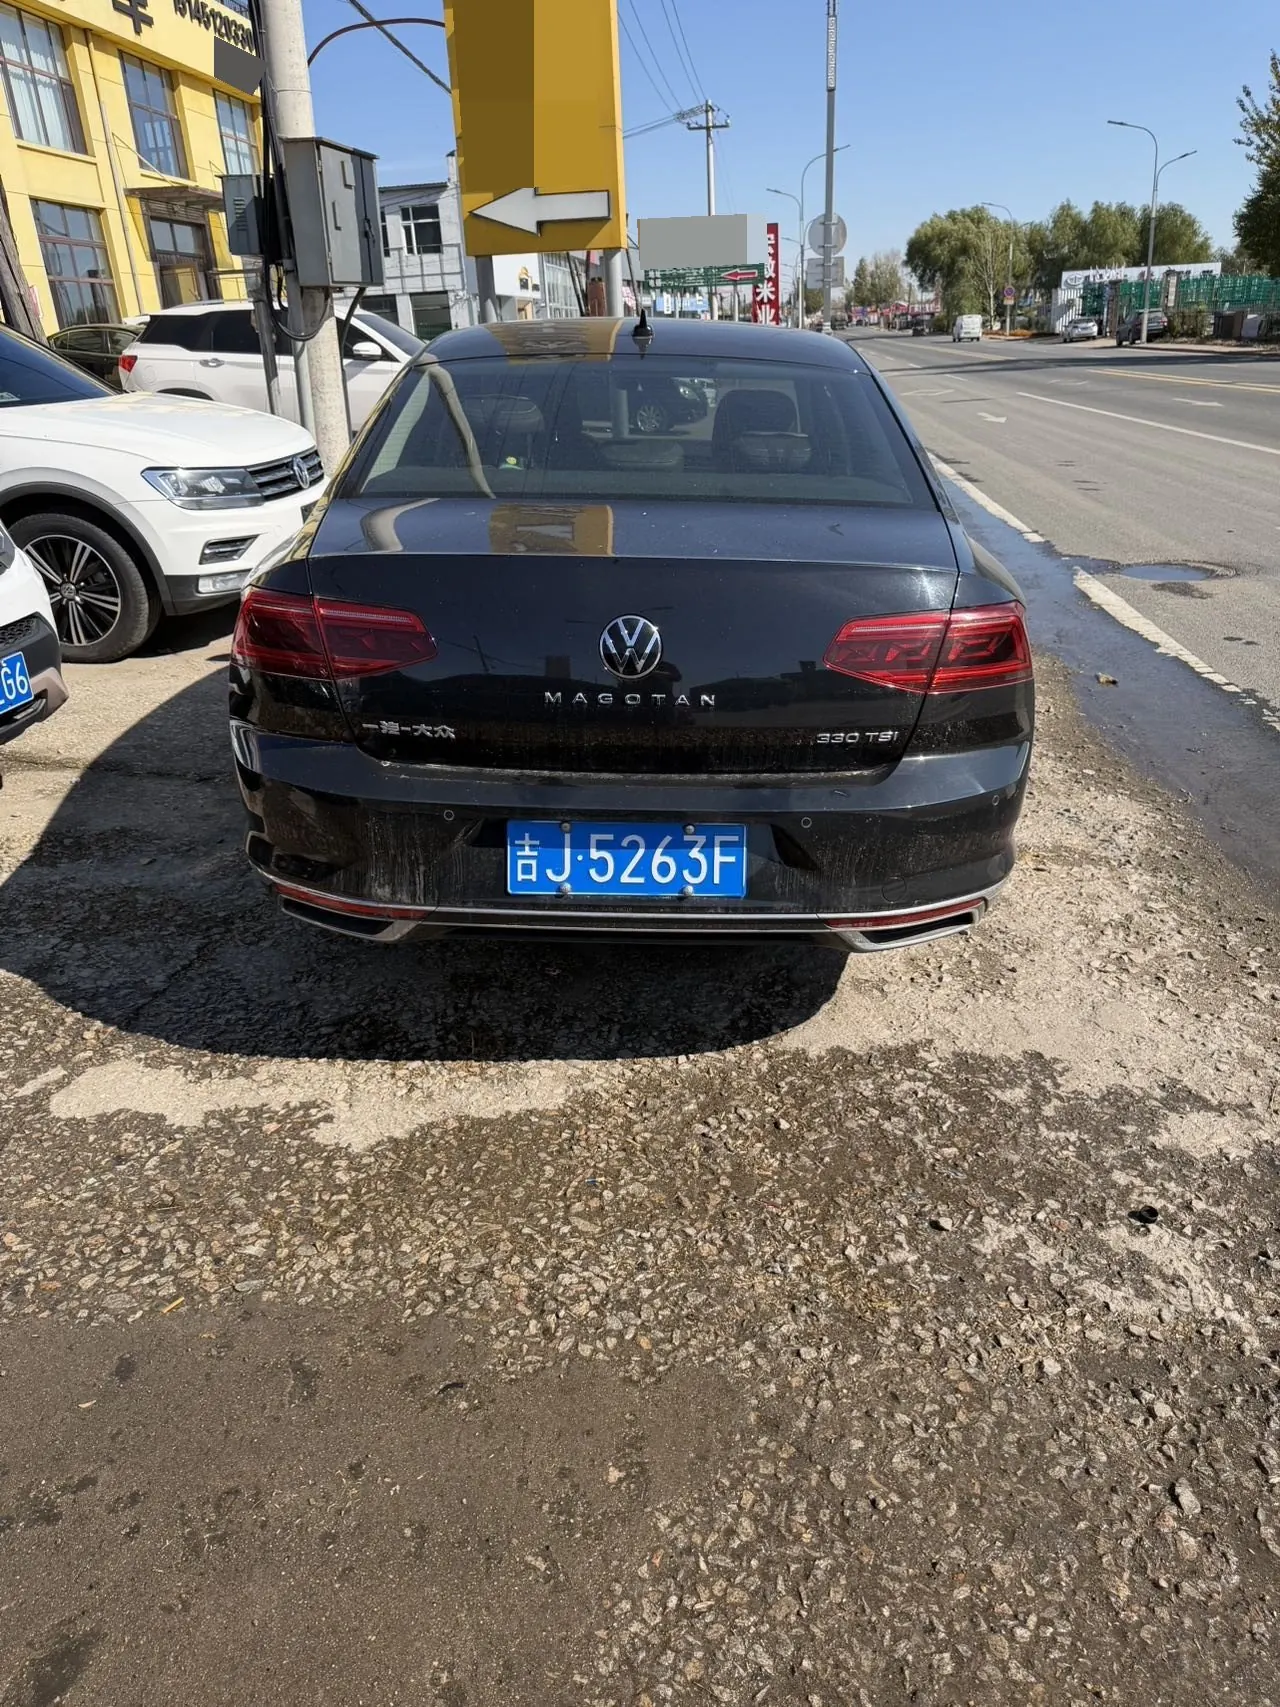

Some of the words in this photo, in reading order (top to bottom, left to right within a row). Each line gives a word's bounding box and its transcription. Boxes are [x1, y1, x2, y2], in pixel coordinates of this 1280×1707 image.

[544, 691, 716, 706] MAGOTAN
[817, 732, 860, 744] 330
[864, 731, 899, 743] TSI
